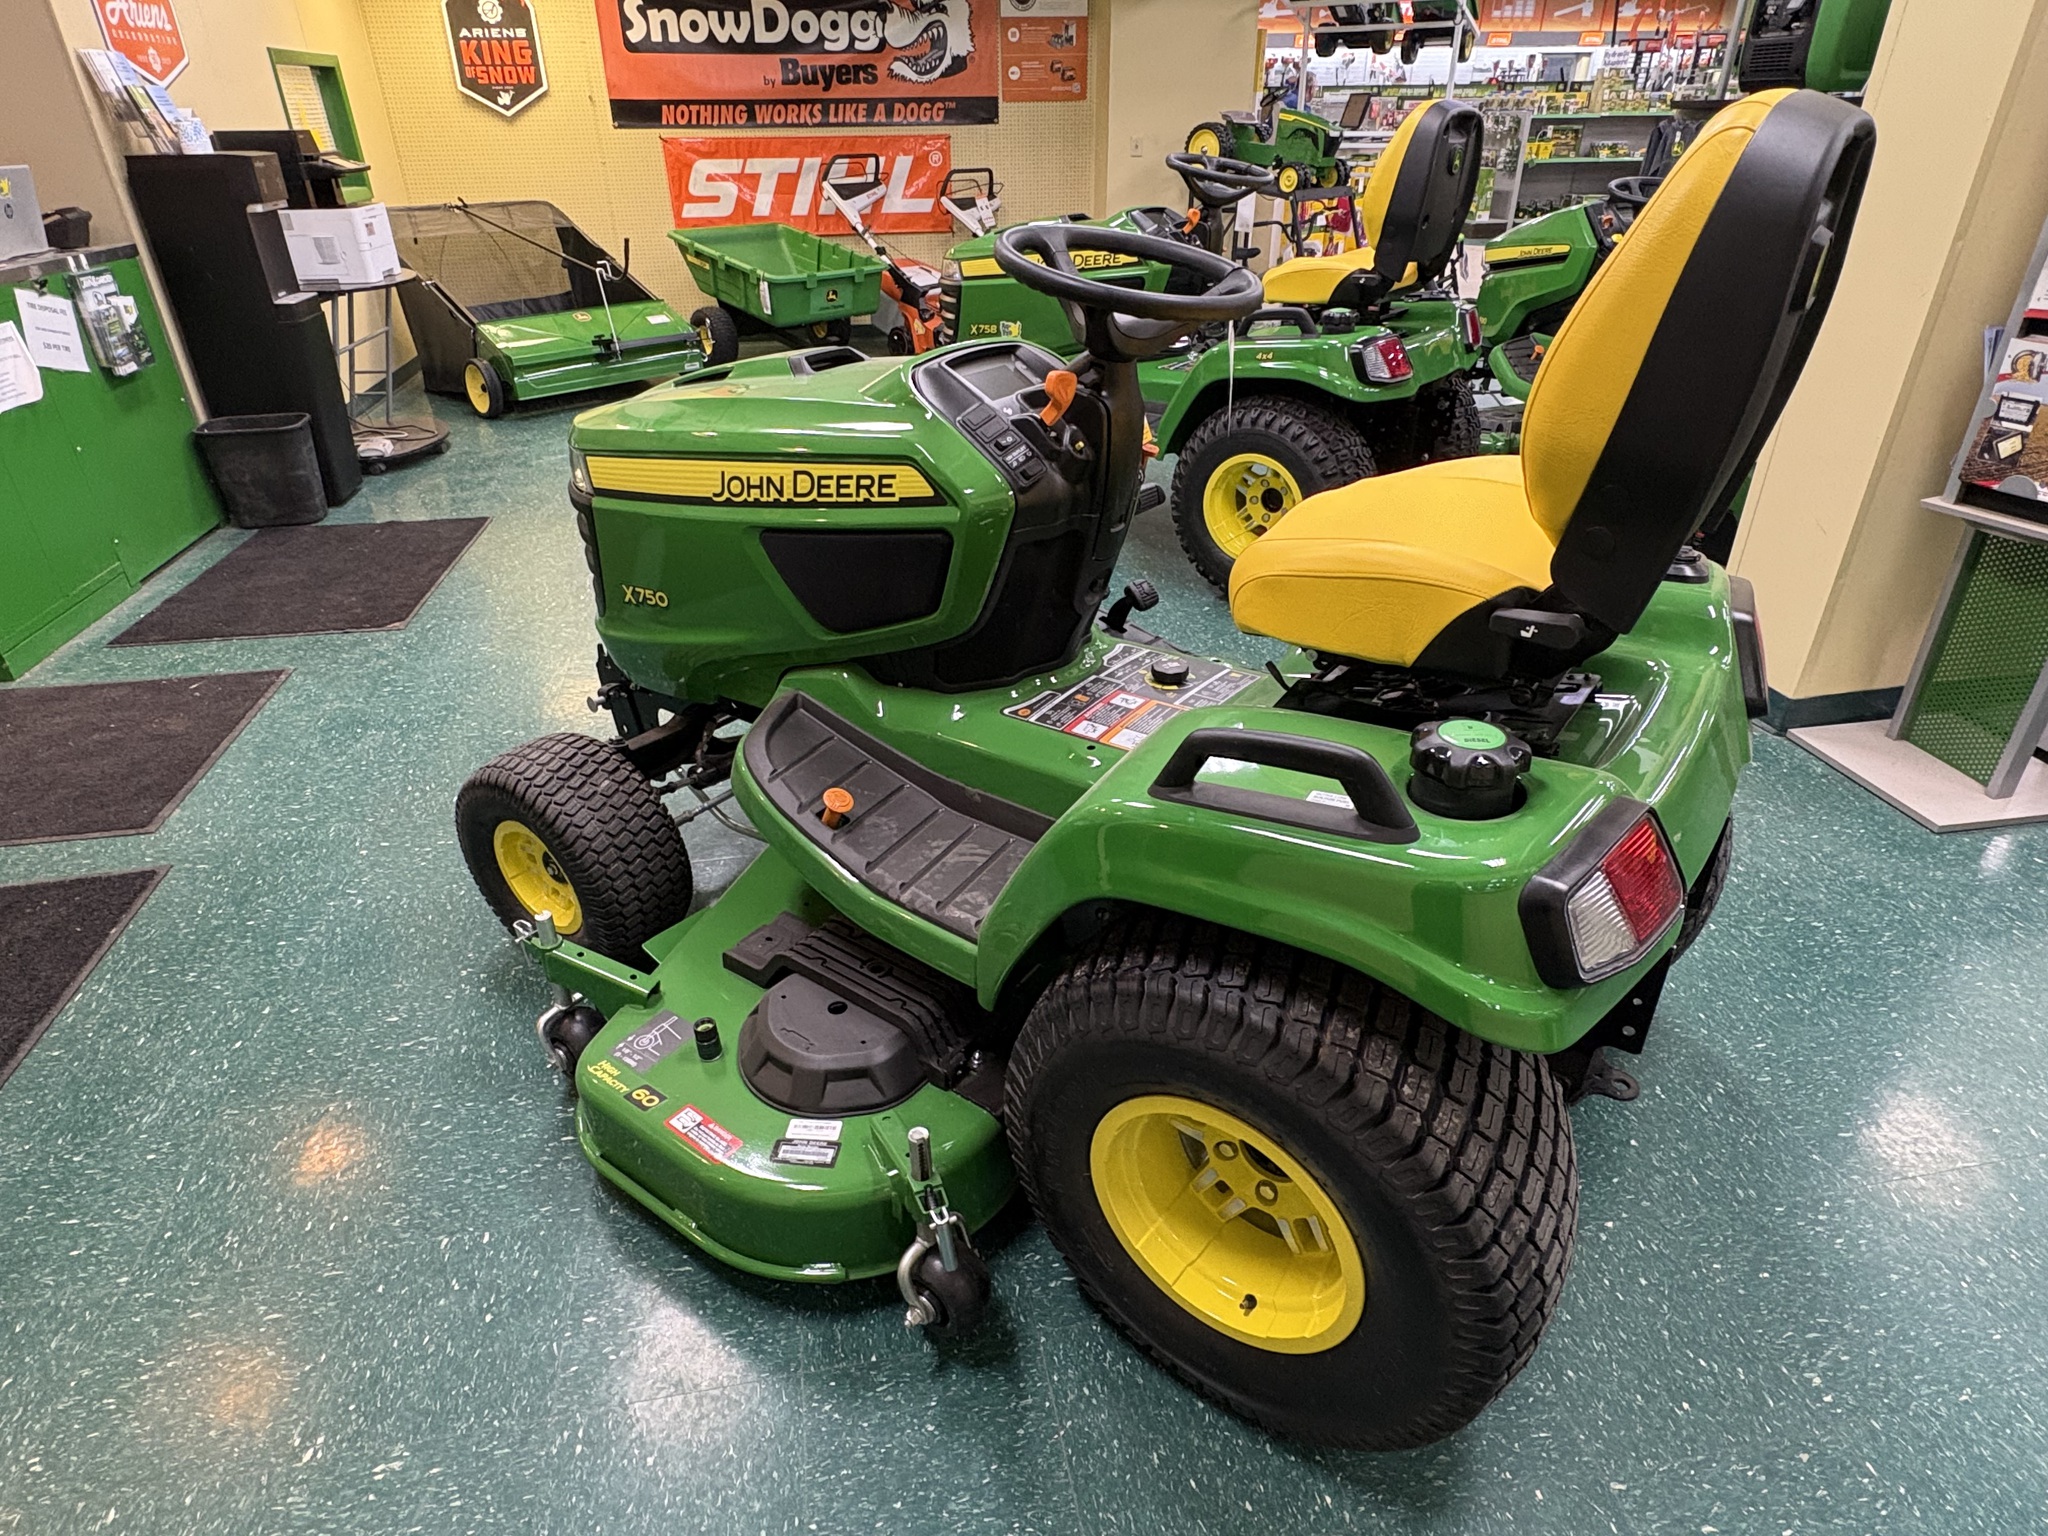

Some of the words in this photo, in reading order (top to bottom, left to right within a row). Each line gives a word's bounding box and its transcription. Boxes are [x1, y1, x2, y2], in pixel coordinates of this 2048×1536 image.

[459, 27, 527, 38] ARIENS
[459, 39, 533, 66] KING
[465, 66, 476, 78] OF
[475, 66, 536, 85] SNOW
[763, 75, 776, 88] by
[779, 58, 878, 92] Buyers
[661, 104, 747, 126] NOTHING
[754, 104, 822, 126] WORKS
[829, 103, 869, 124] LIKE
[873, 103, 885, 123] A
[1073, 253, 1122, 267] DEERE
[1533, 247, 1553, 256] DEERE
[1255, 351, 1274, 360] 4x4
[712, 470, 785, 498] JOHN
[793, 470, 897, 498] DEERE
[621, 584, 669, 608] X750
[597, 1060, 621, 1077] HIGH
[587, 1065, 630, 1093] CAPACITY
[631, 1088, 660, 1108] 60
